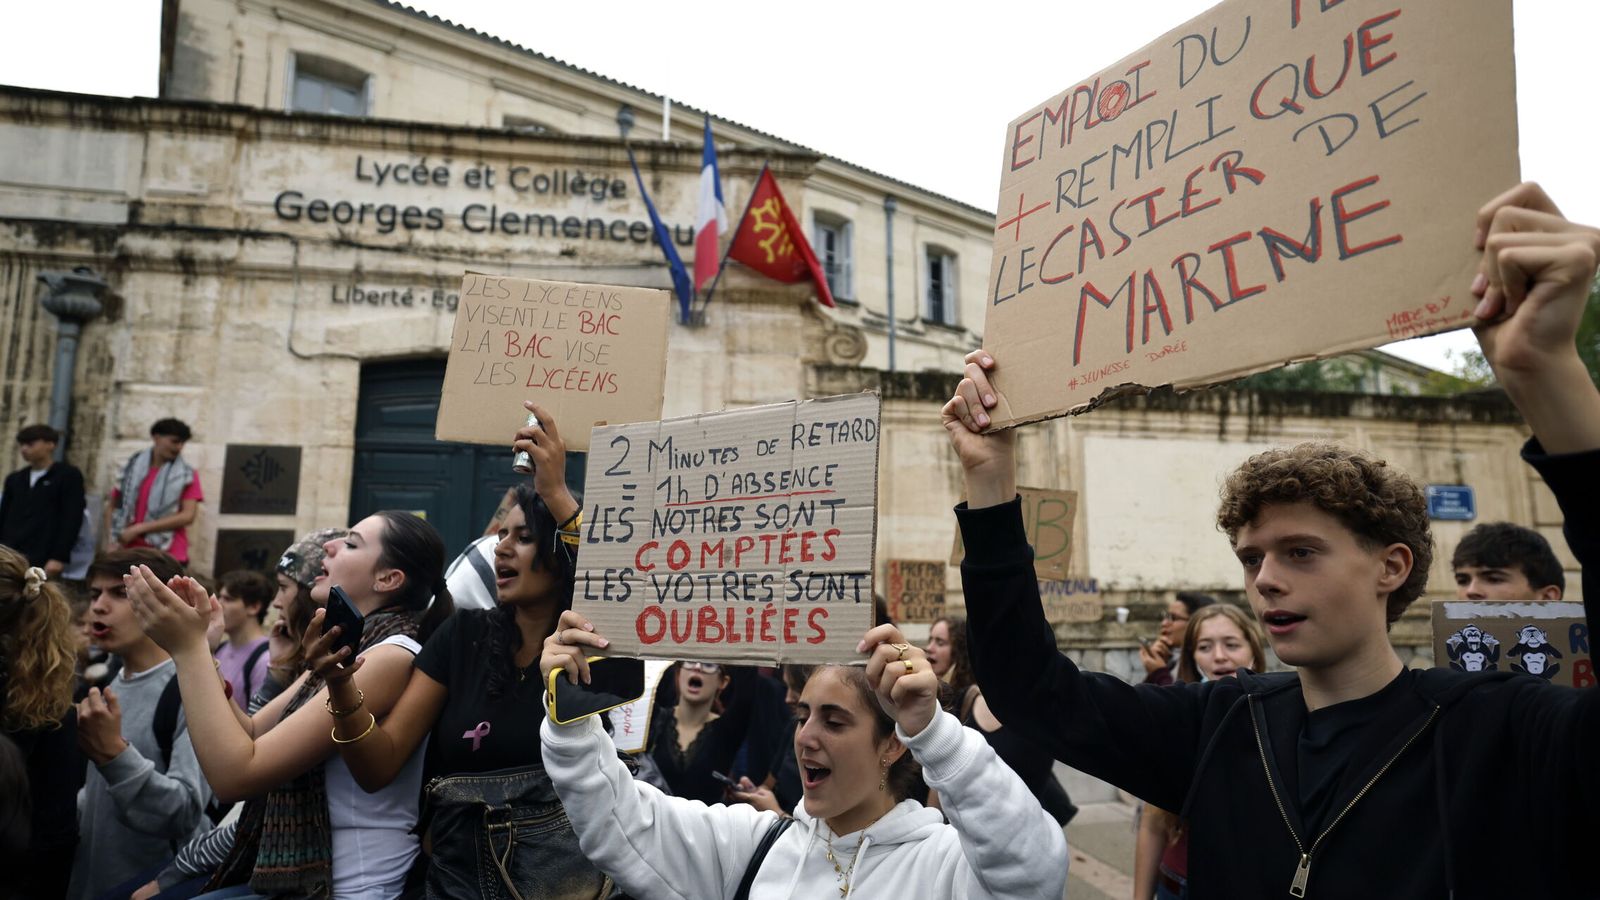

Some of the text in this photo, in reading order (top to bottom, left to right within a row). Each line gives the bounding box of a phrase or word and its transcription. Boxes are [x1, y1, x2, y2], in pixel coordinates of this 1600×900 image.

[1011, 15, 1251, 172] EMPLOI DU
[1055, 94, 1236, 213] REMPLI
[1250, 9, 1402, 120] QUE
[1293, 80, 1428, 156] DE
[356, 155, 628, 201] Lycée et Collège
[274, 190, 444, 234] Georges
[466, 276, 624, 310] LES LYCÉENS
[1073, 175, 1403, 367] MARINE
[331, 283, 414, 308] Liberté
[465, 303, 621, 336] VISENT LE BAC
[460, 329, 611, 366] LA BAC VISE
[473, 361, 619, 394] LES LYCÉENS
[605, 434, 631, 476] 2
[756, 438, 779, 457] DE
[791, 417, 876, 451] RETARD
[656, 463, 839, 504] 1h D'ABSENCE
[587, 498, 846, 544] LES NOTRES SONT
[634, 528, 842, 573] COMPTÉES
[584, 567, 634, 602] LES
[651, 570, 775, 604] VOTRES
[785, 569, 869, 603] SONT
